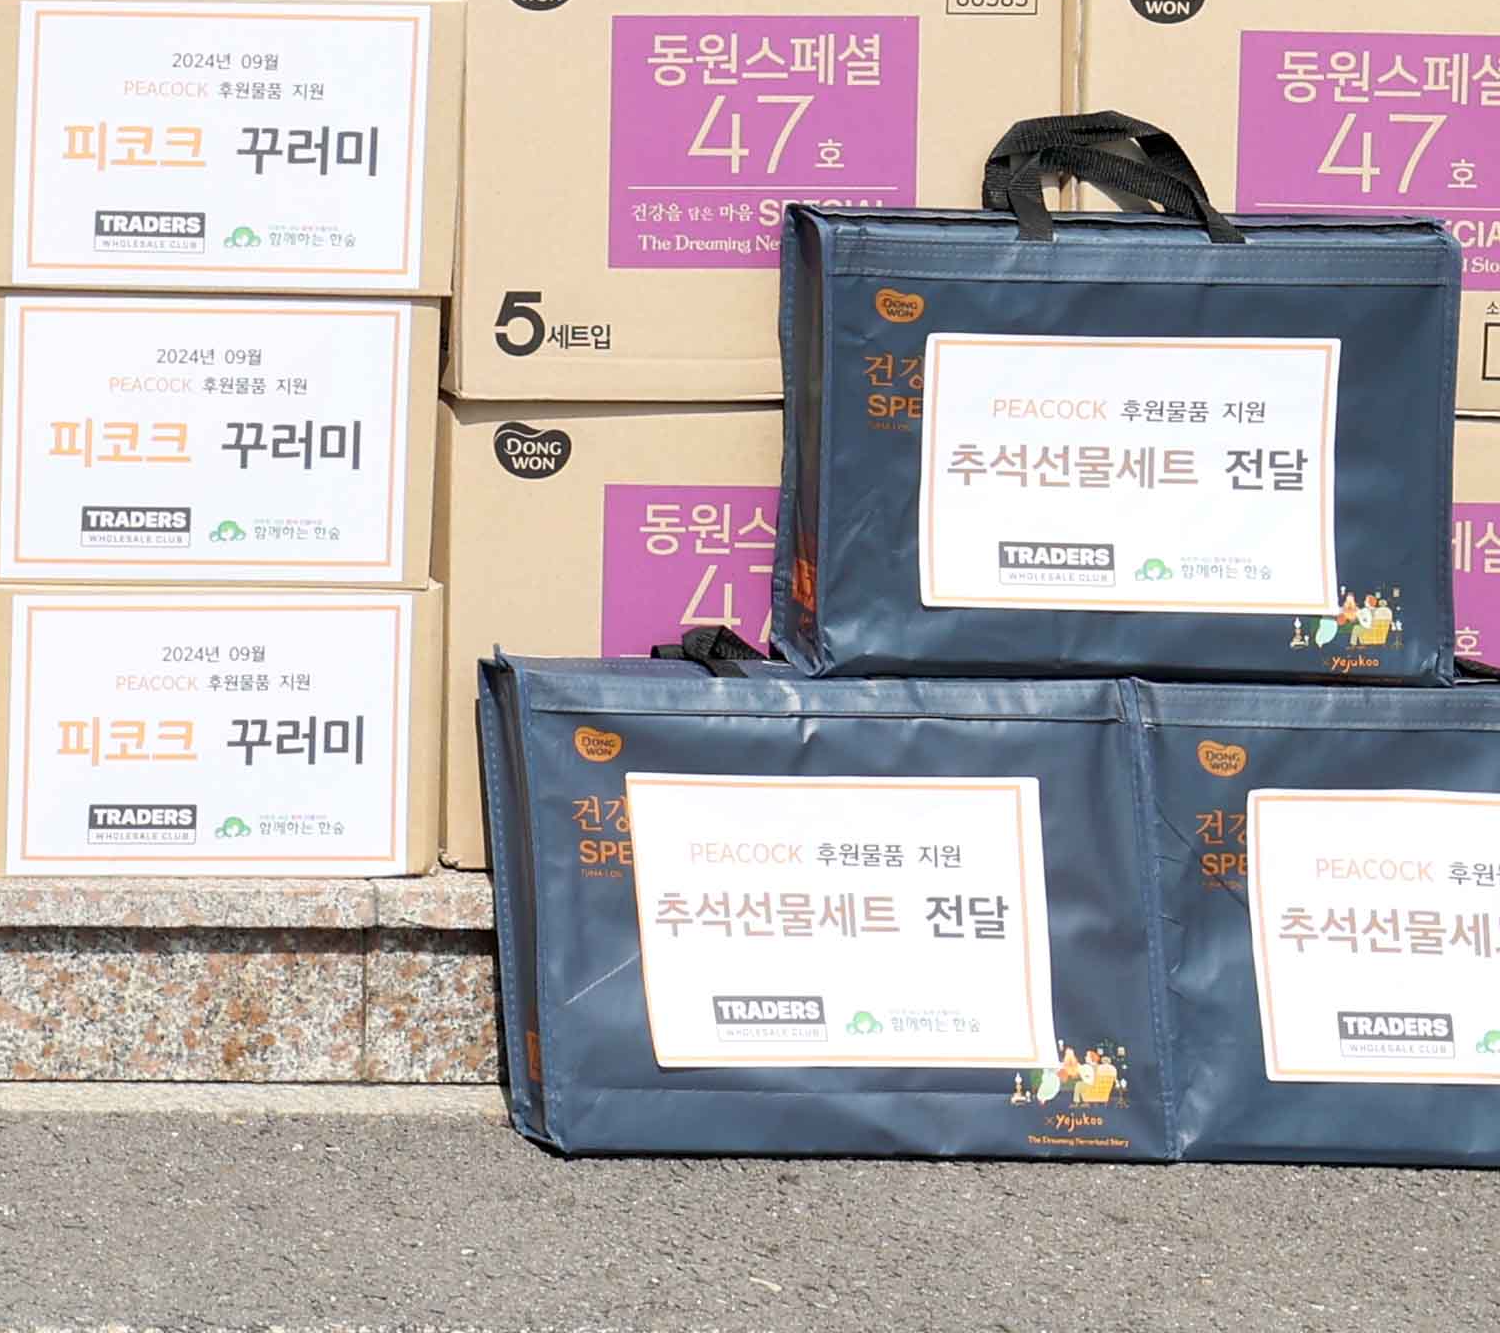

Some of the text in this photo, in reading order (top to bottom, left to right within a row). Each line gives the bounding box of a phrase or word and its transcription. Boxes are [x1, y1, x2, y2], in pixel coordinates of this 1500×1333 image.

[690, 842, 962, 868] PEACOCK 후원물품 지원
[656, 891, 1009, 941] 추석선물세트 전달
[718, 999, 821, 1021] TRADERS
